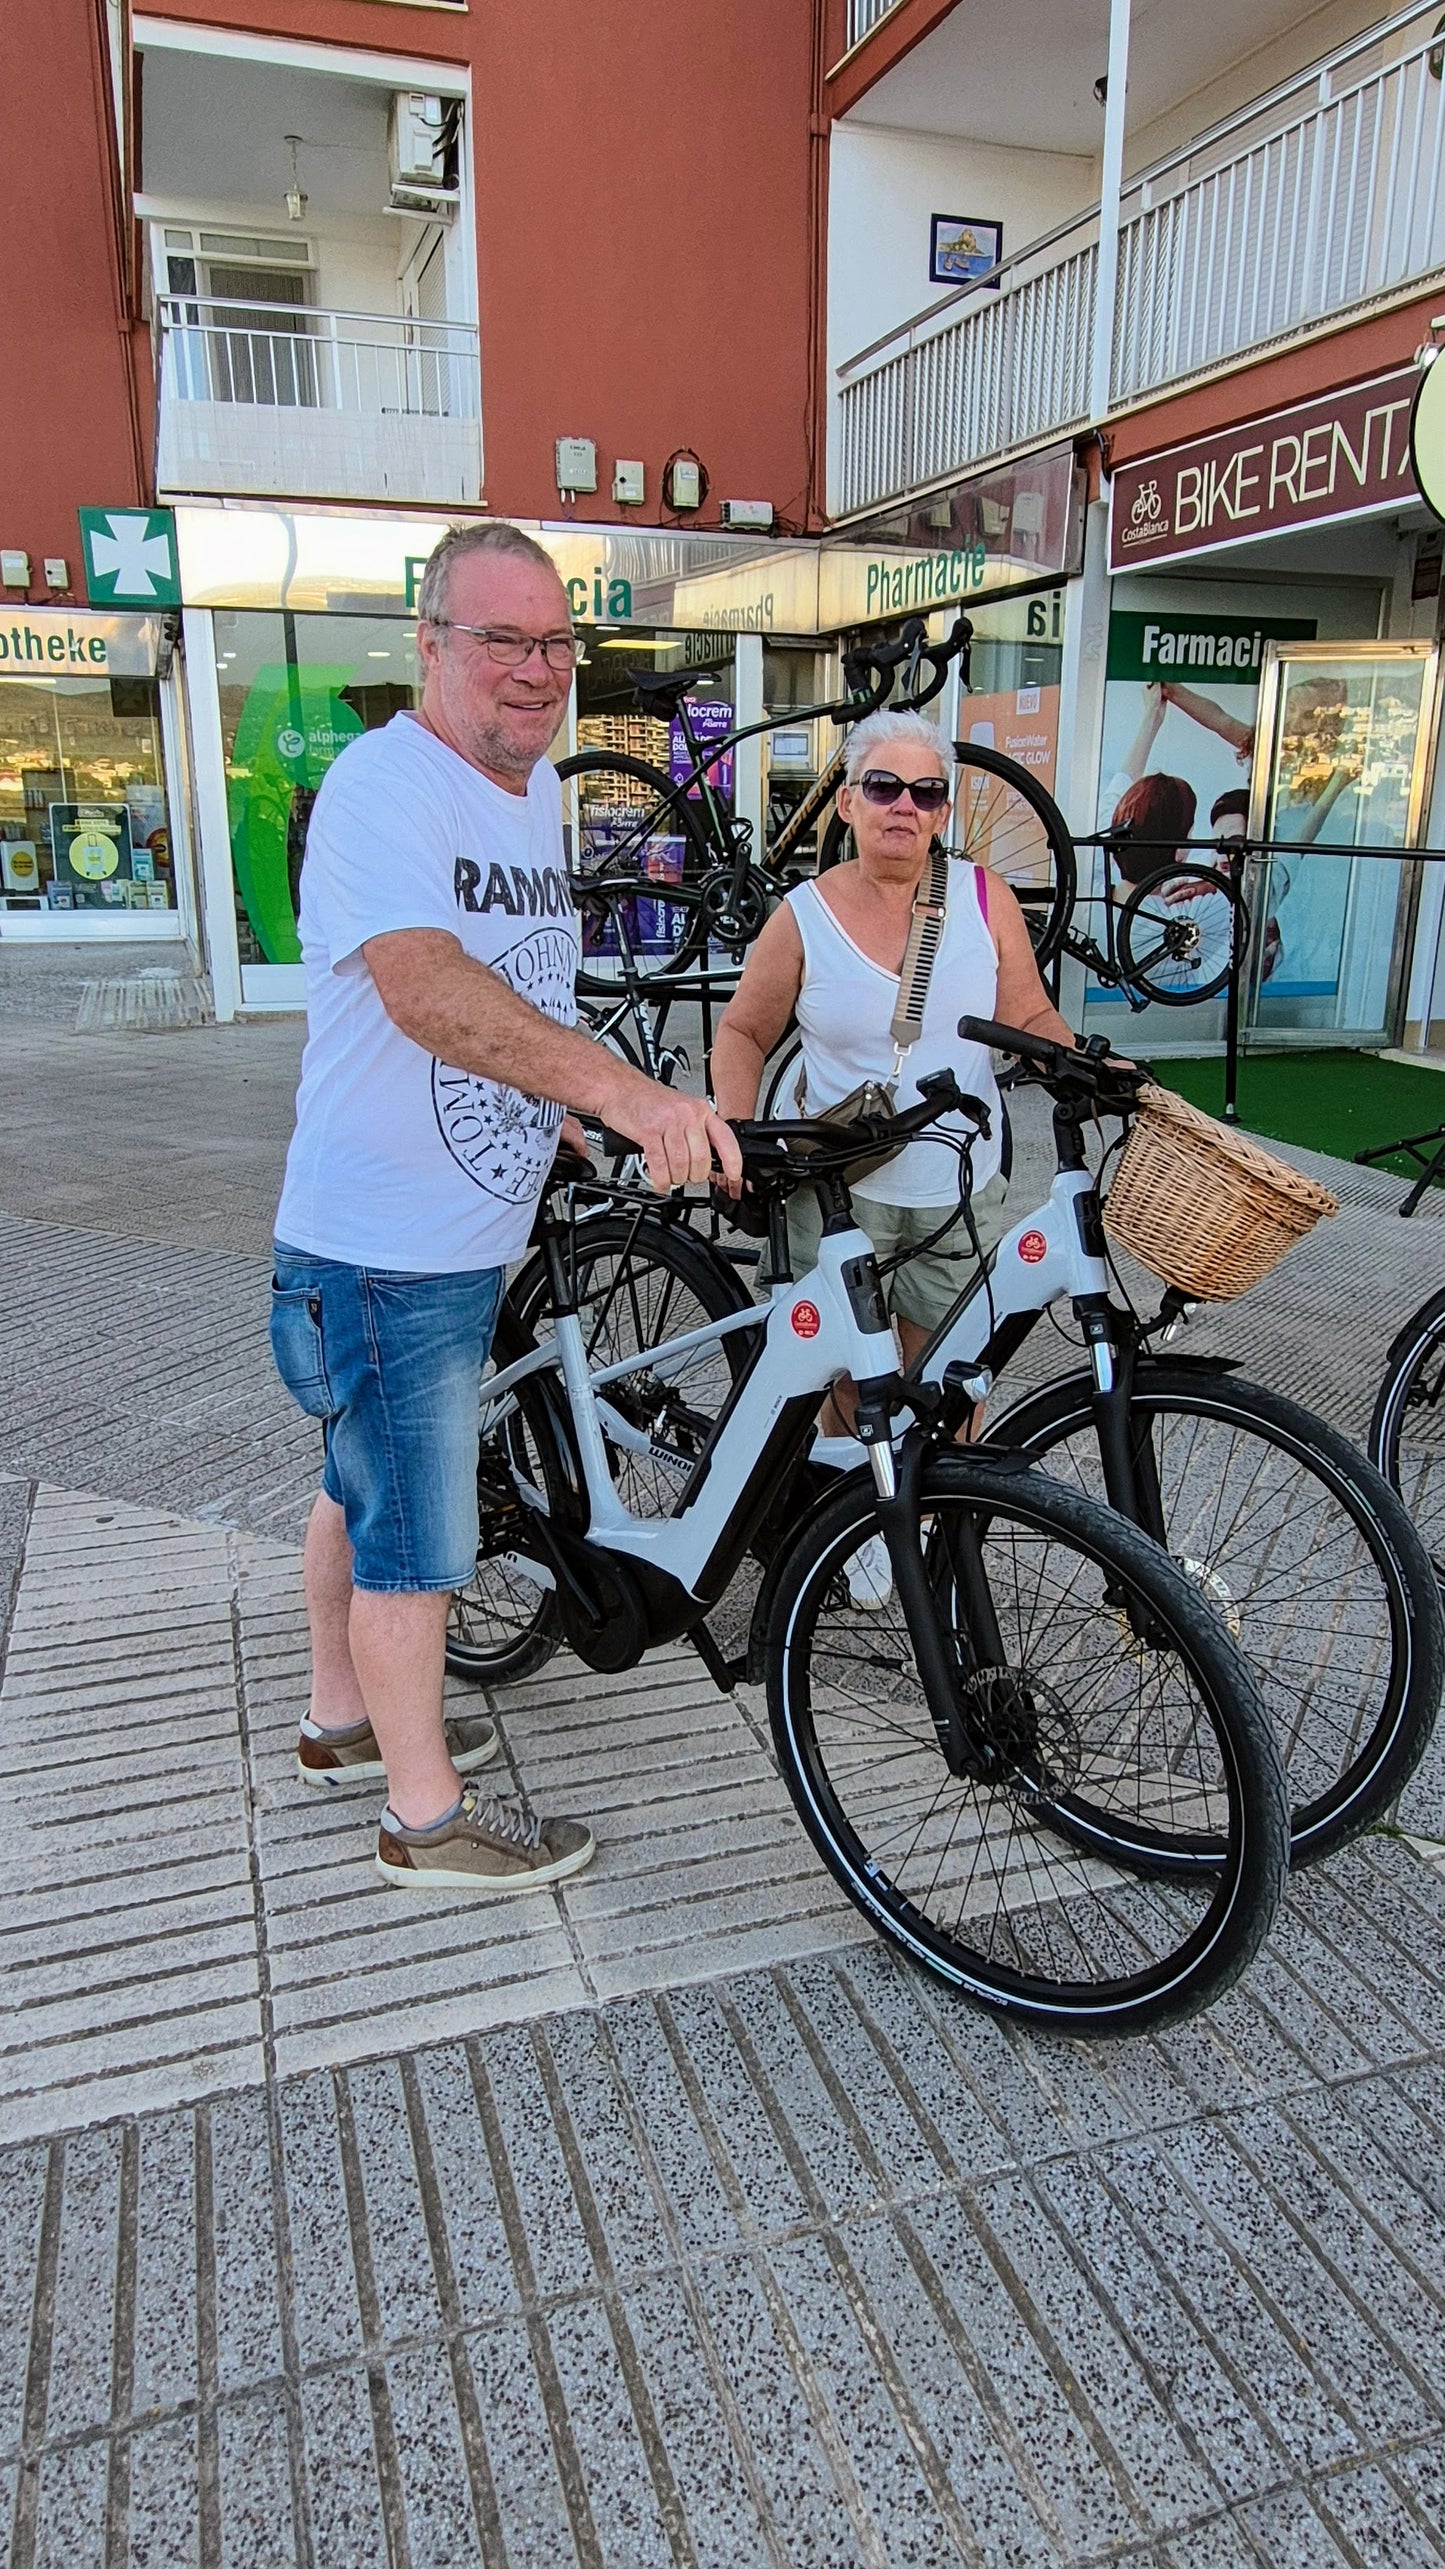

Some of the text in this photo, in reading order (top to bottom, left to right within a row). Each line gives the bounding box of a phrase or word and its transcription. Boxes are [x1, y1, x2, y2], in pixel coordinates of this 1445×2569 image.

[1174, 397, 1411, 536] BIKE RENT
[1121, 519, 1170, 544] CostaBlanca
[866, 533, 986, 615] Pharmacie
[1142, 625, 1276, 668] Farmaci
[453, 856, 575, 918] RAMON
